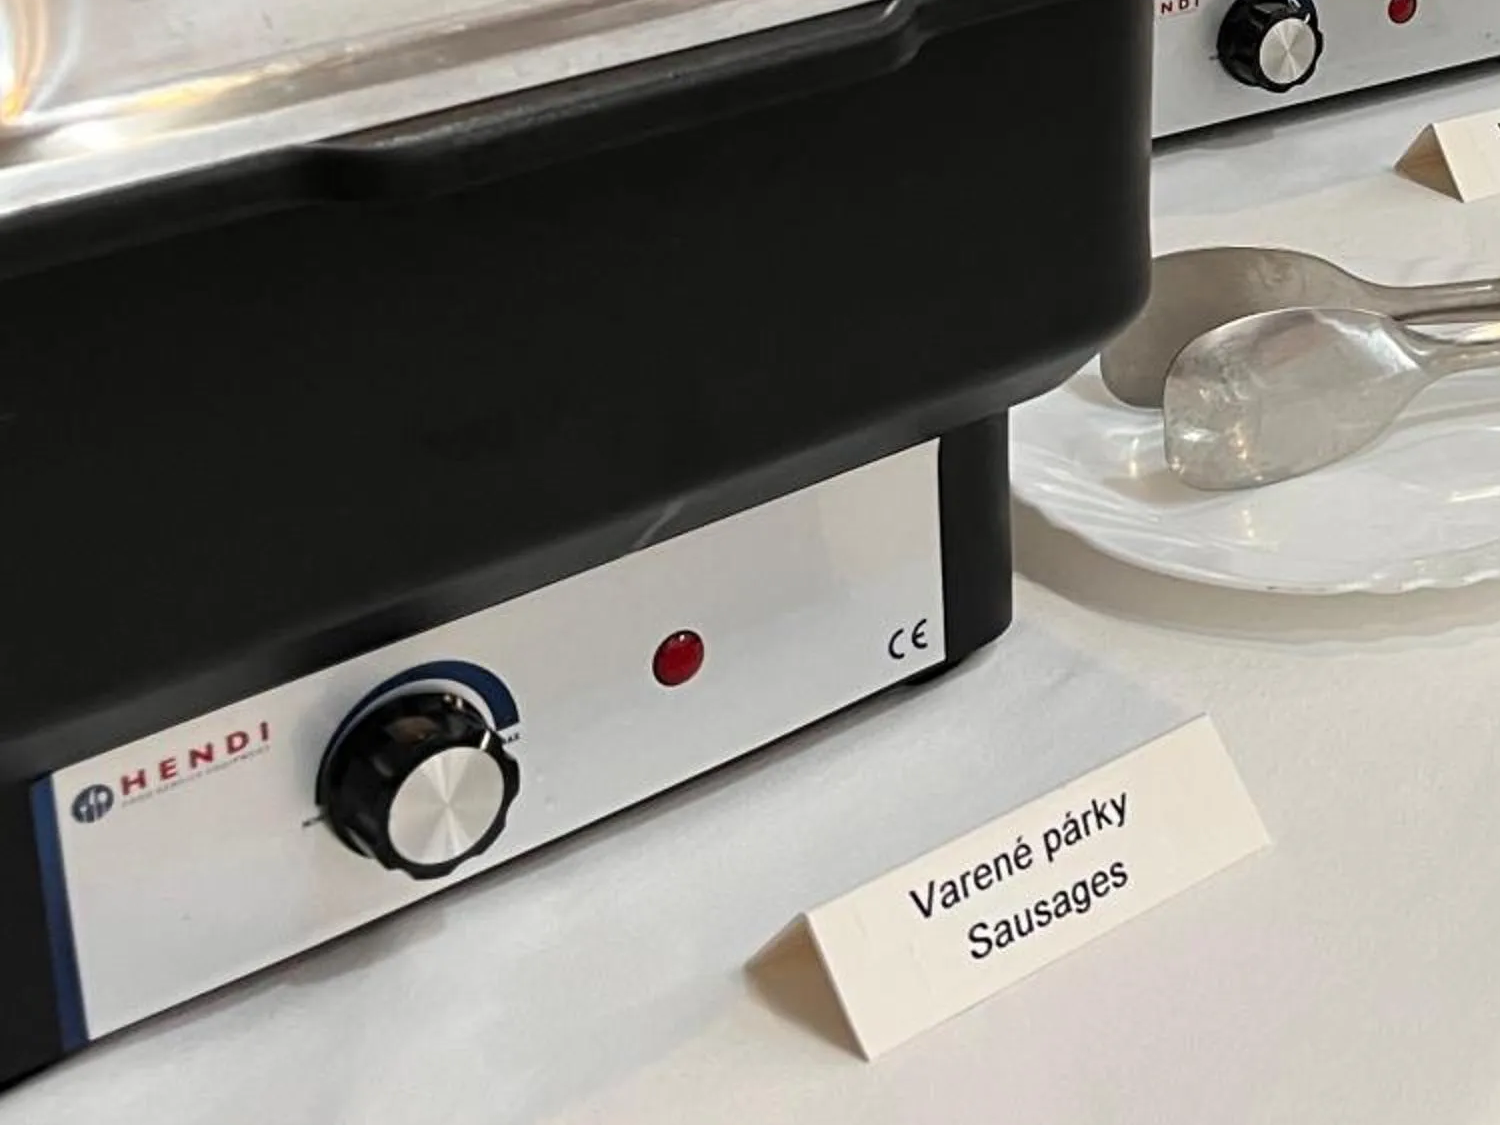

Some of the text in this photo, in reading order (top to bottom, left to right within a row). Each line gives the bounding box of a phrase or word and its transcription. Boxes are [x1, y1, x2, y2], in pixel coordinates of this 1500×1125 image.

[888, 618, 928, 660] CE
[120, 721, 270, 796] HENDI
[909, 792, 1128, 919] Varené párky
[967, 860, 1130, 960] Sausages
